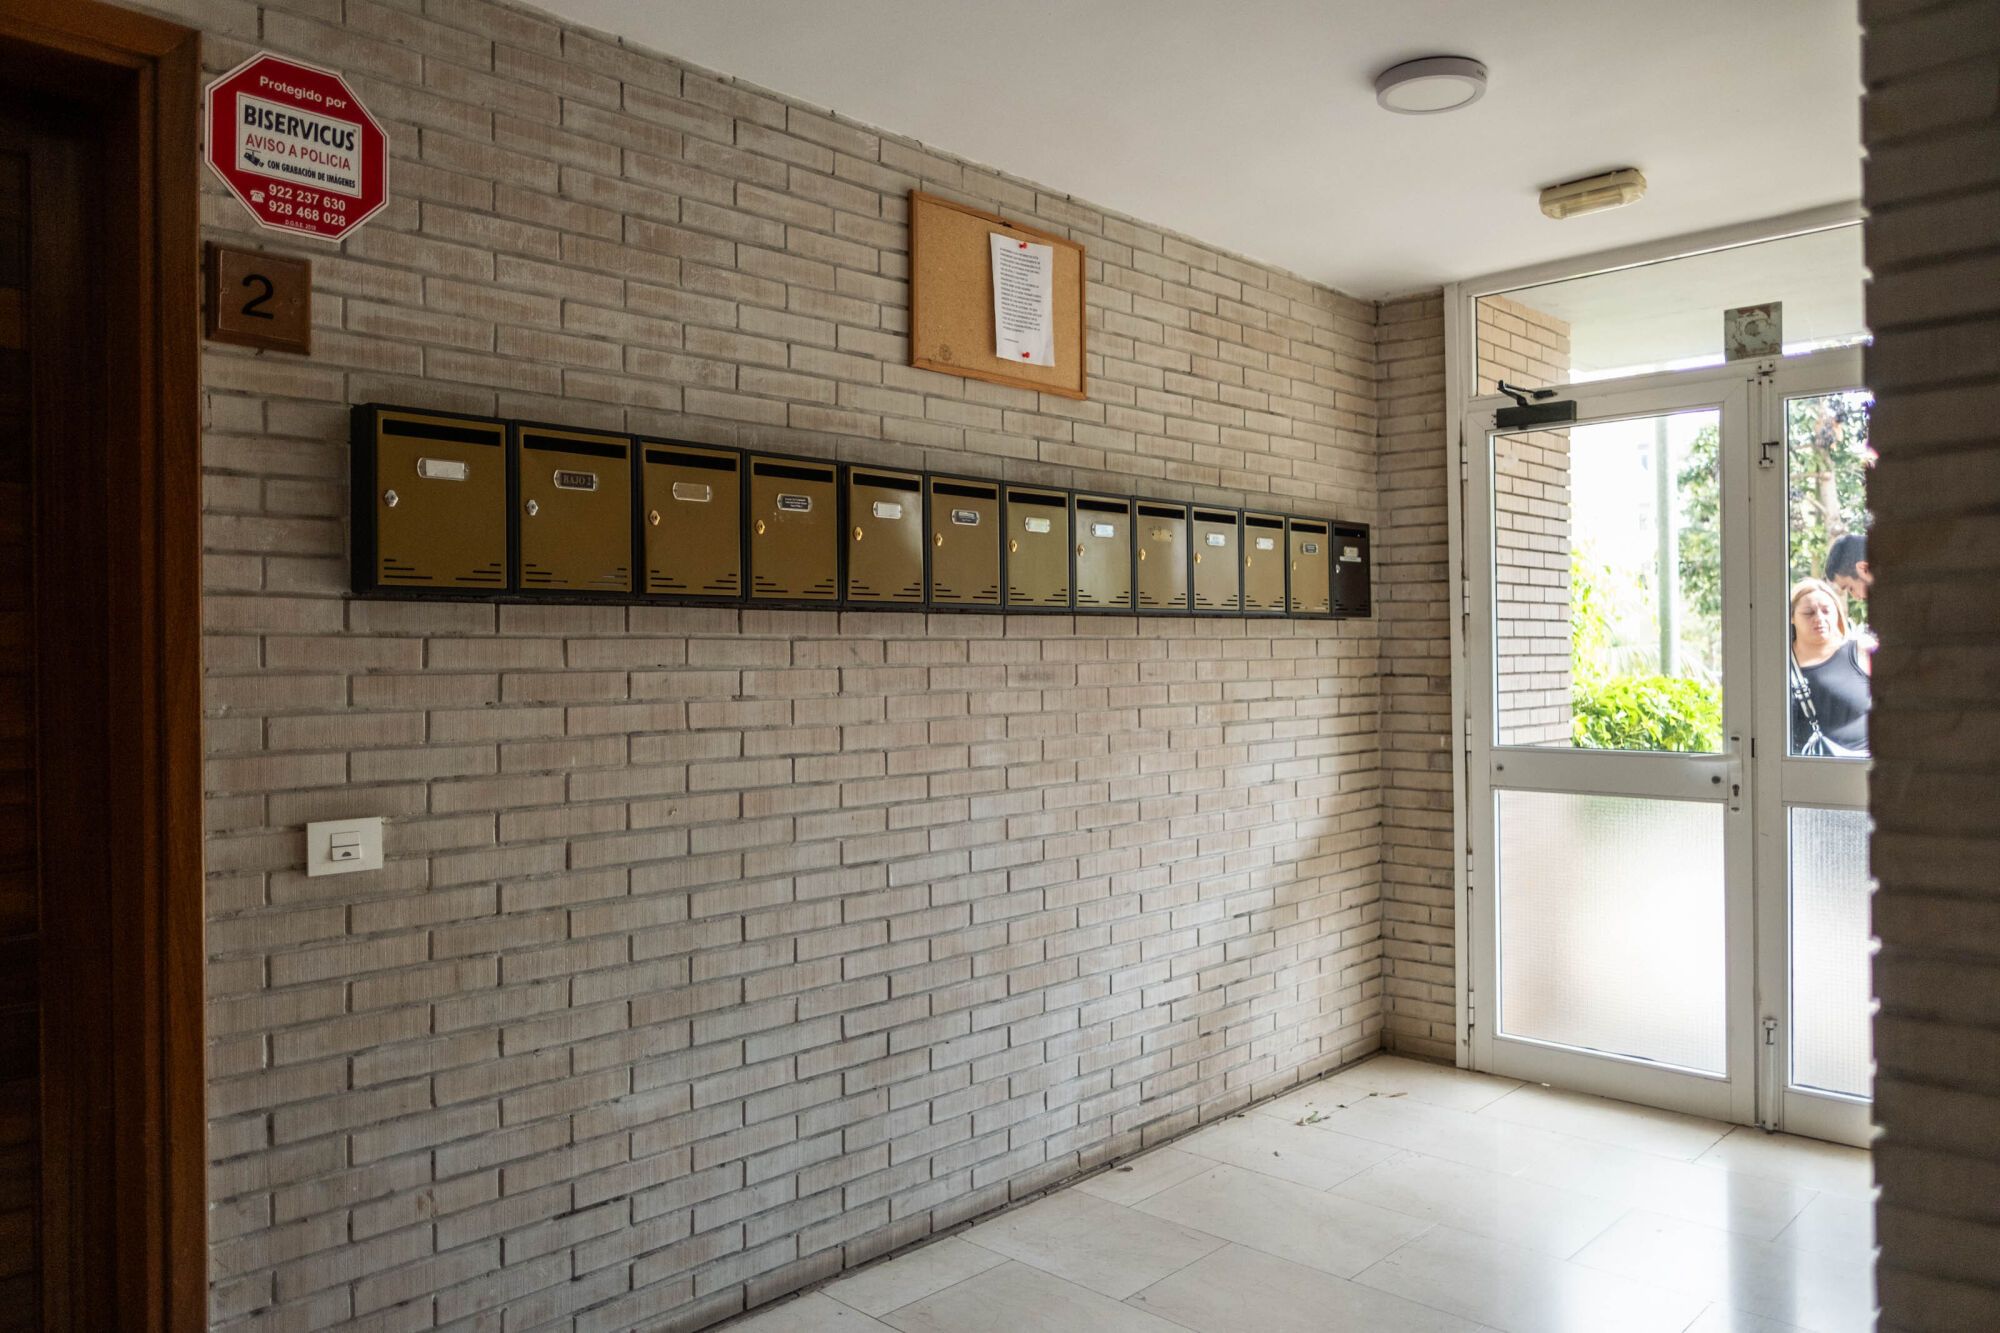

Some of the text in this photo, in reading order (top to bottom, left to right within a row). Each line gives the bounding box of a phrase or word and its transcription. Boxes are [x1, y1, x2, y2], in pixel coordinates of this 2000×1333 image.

[259, 75, 347, 110] Protegido por
[244, 104, 354, 152] BISERVICUS
[245, 133, 351, 171] AVISO A POLICIA
[267, 160, 280, 170] CON
[281, 163, 316, 179] GRABACIÓN
[317, 172, 325, 181] DE
[268, 184, 346, 212] 922 237 630
[268, 200, 346, 227] 928 468 028
[240, 273, 275, 320] 2
